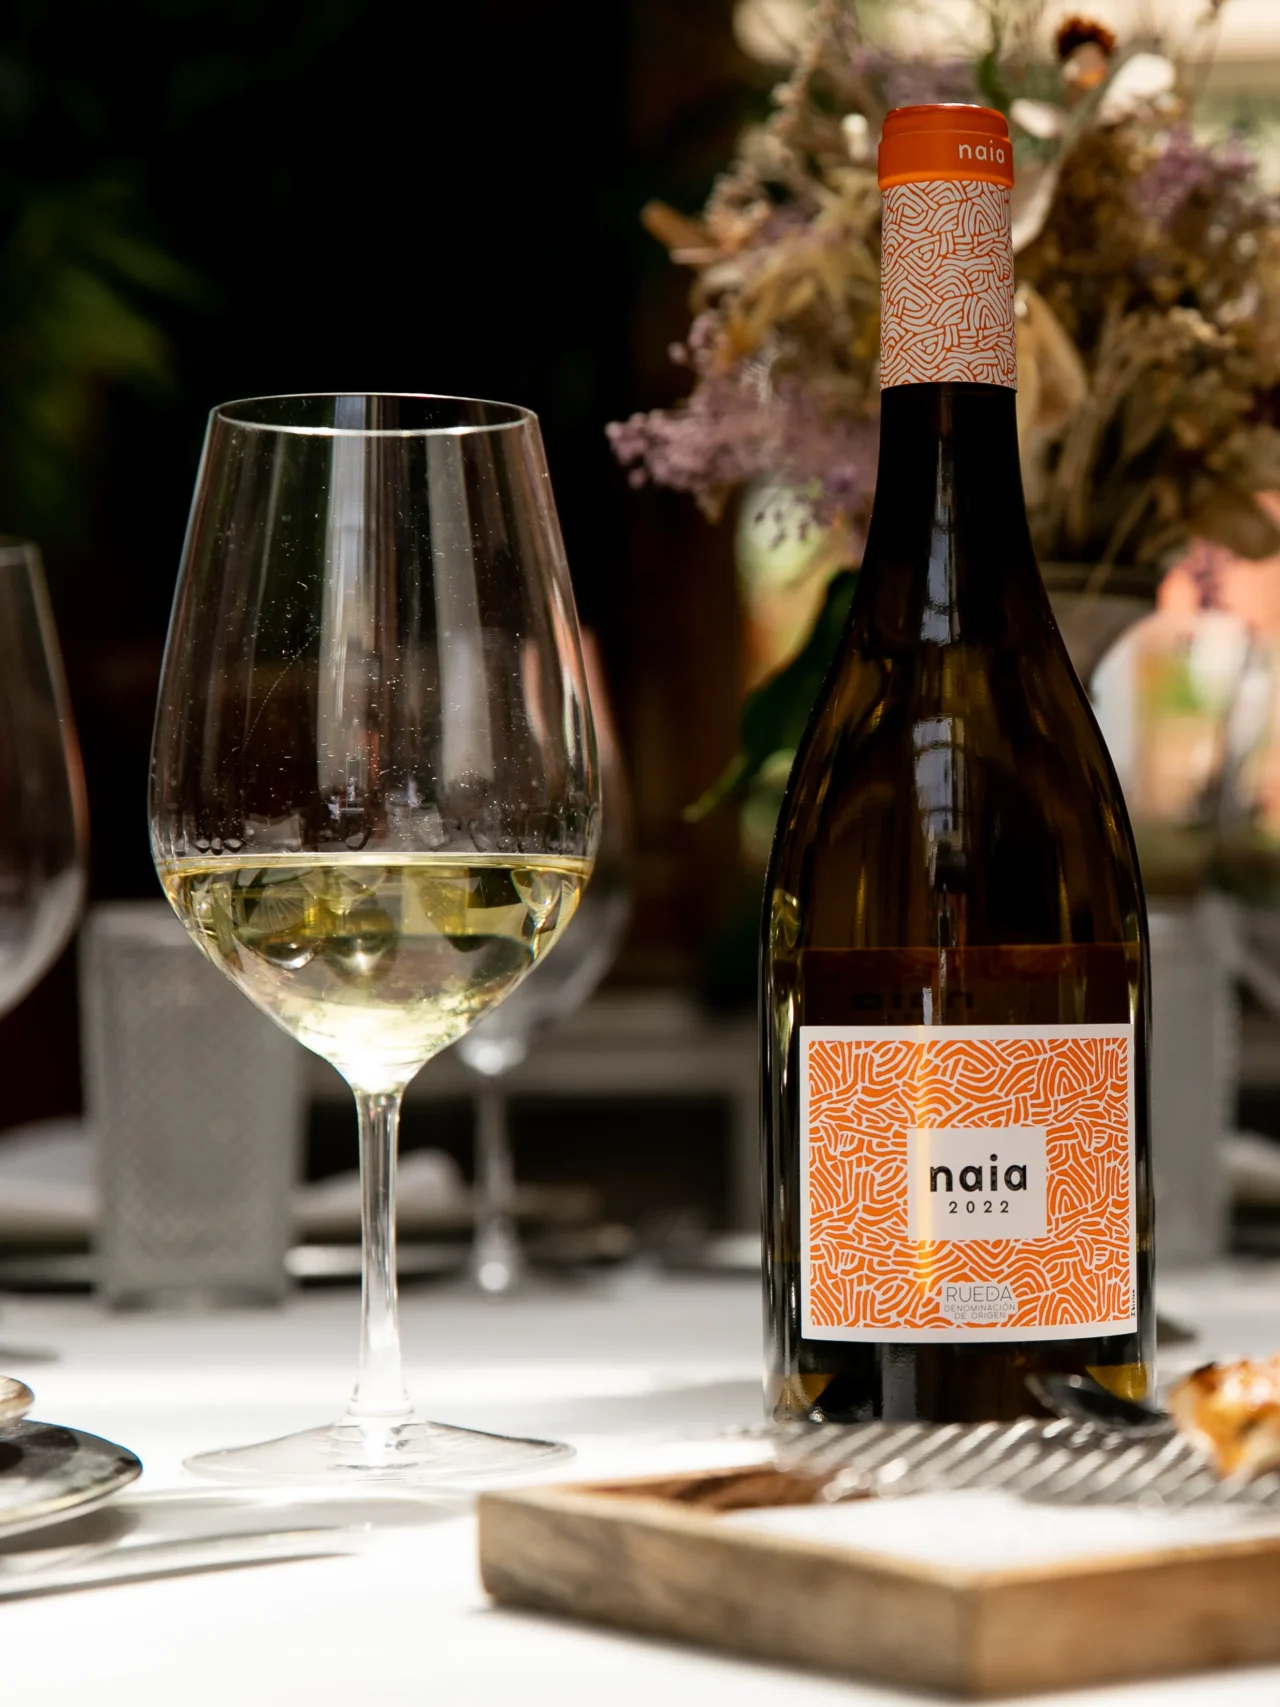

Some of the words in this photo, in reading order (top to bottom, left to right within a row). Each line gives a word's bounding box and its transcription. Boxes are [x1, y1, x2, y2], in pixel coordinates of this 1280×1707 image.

[958, 140, 1005, 164] naia
[930, 1153, 1027, 1192] naia
[948, 1200, 1009, 1214] 2022
[946, 1286, 1012, 1302] RUEDA
[944, 1302, 1016, 1313] DENOMINACIÓN
[954, 1312, 966, 1320] DE
[971, 1311, 1006, 1320] ORIGEN
